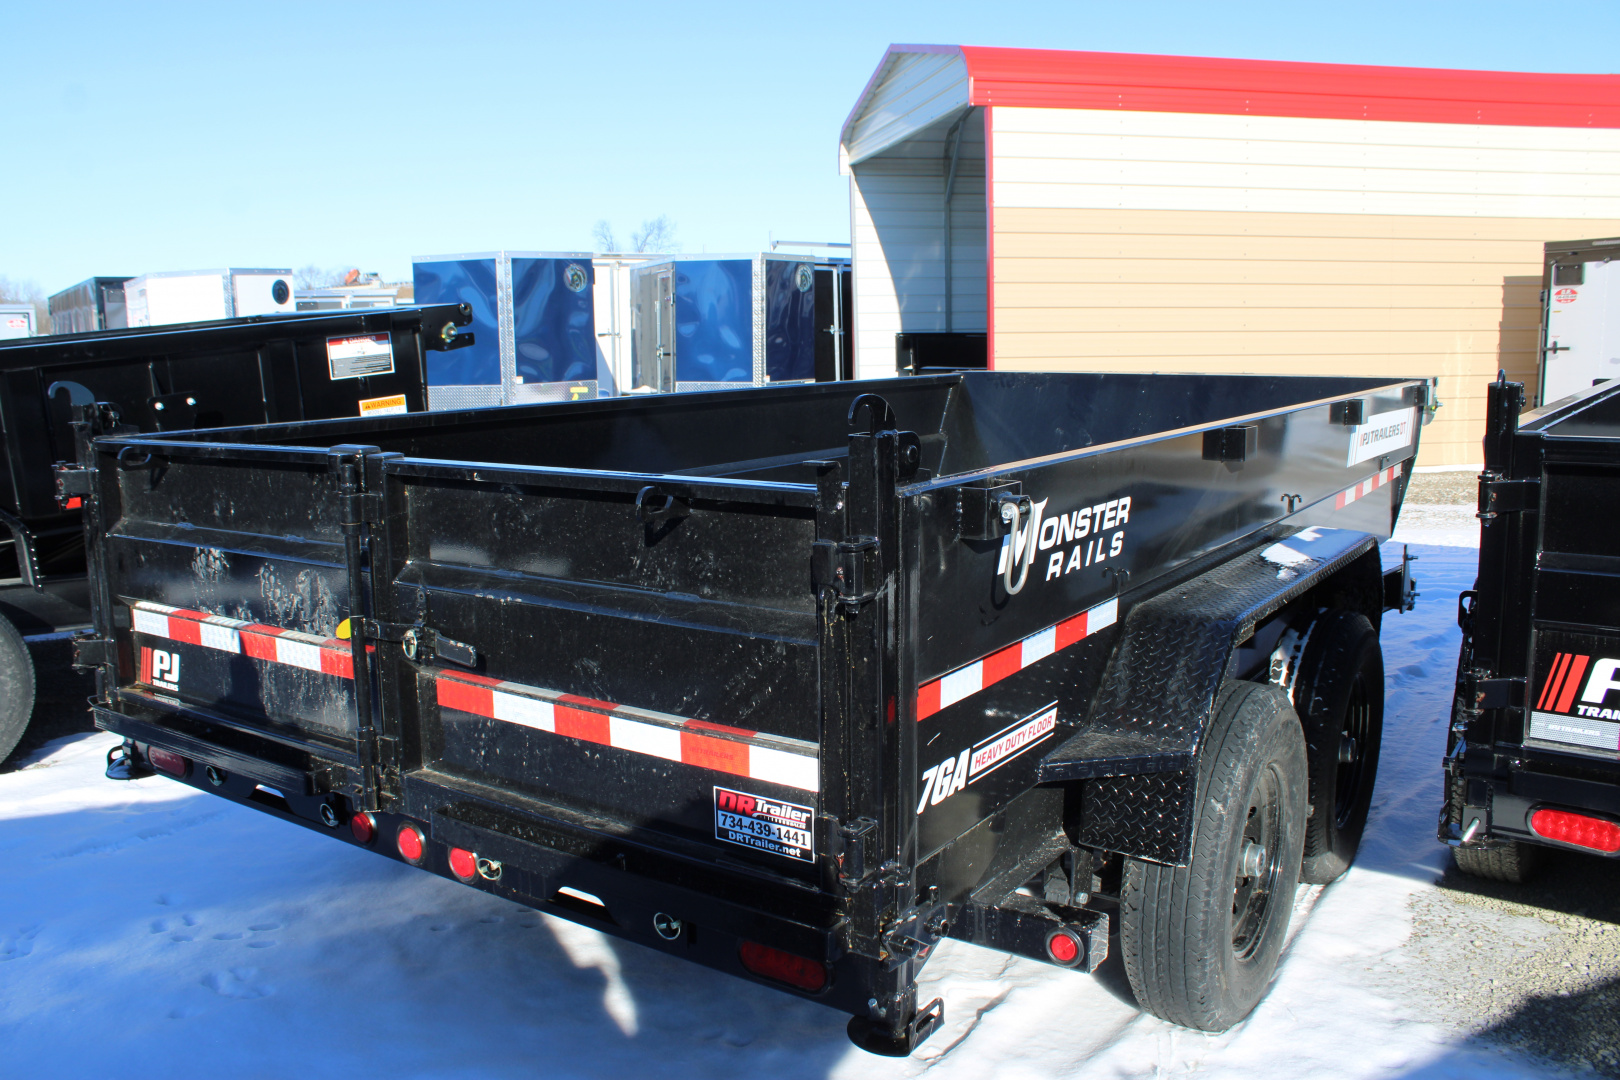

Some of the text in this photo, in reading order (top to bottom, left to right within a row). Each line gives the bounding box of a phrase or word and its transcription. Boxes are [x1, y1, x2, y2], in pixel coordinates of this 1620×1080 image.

[349, 335, 376, 344] DANGER
[370, 398, 402, 408] WARNING
[997, 496, 1132, 575] MONSTER
[1045, 530, 1125, 582] RAILS
[152, 649, 180, 682] PJ
[152, 679, 179, 692] TRAILERS
[916, 715, 1053, 815] 7GA HEAVY DUTY FLOOR
[720, 813, 807, 847] 734-439-1441
[728, 831, 801, 857] DRTrailer.net
